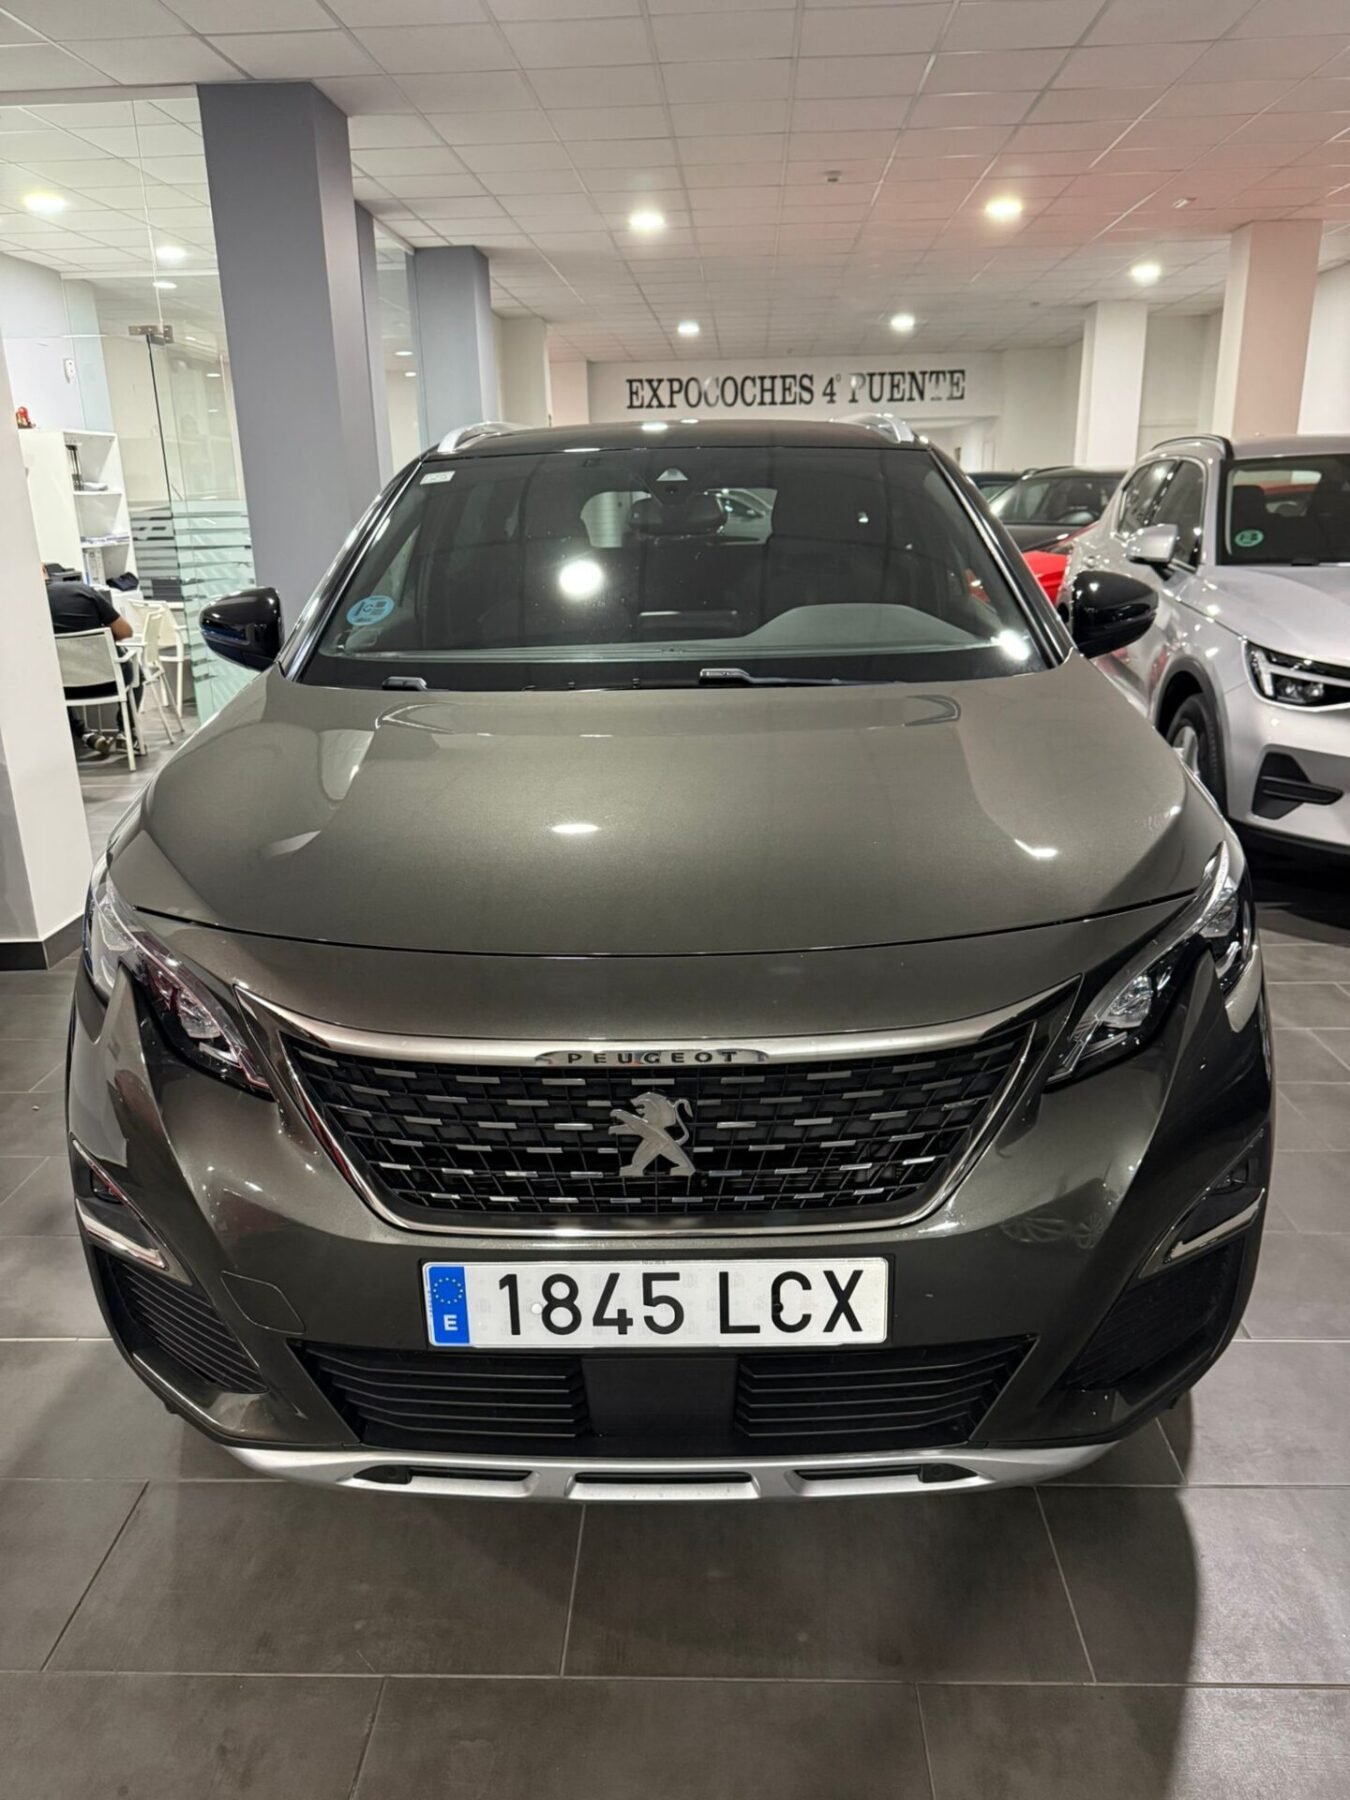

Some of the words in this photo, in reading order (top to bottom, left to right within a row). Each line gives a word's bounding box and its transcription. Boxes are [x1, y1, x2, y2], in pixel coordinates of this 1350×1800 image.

[626, 374, 815, 409] EXPOCOCHES
[848, 369, 966, 403] PUENTE
[567, 1051, 737, 1064] PEUGEOT
[443, 1314, 459, 1331] E
[498, 1272, 684, 1336] 1845
[719, 1269, 864, 1334] LCX
